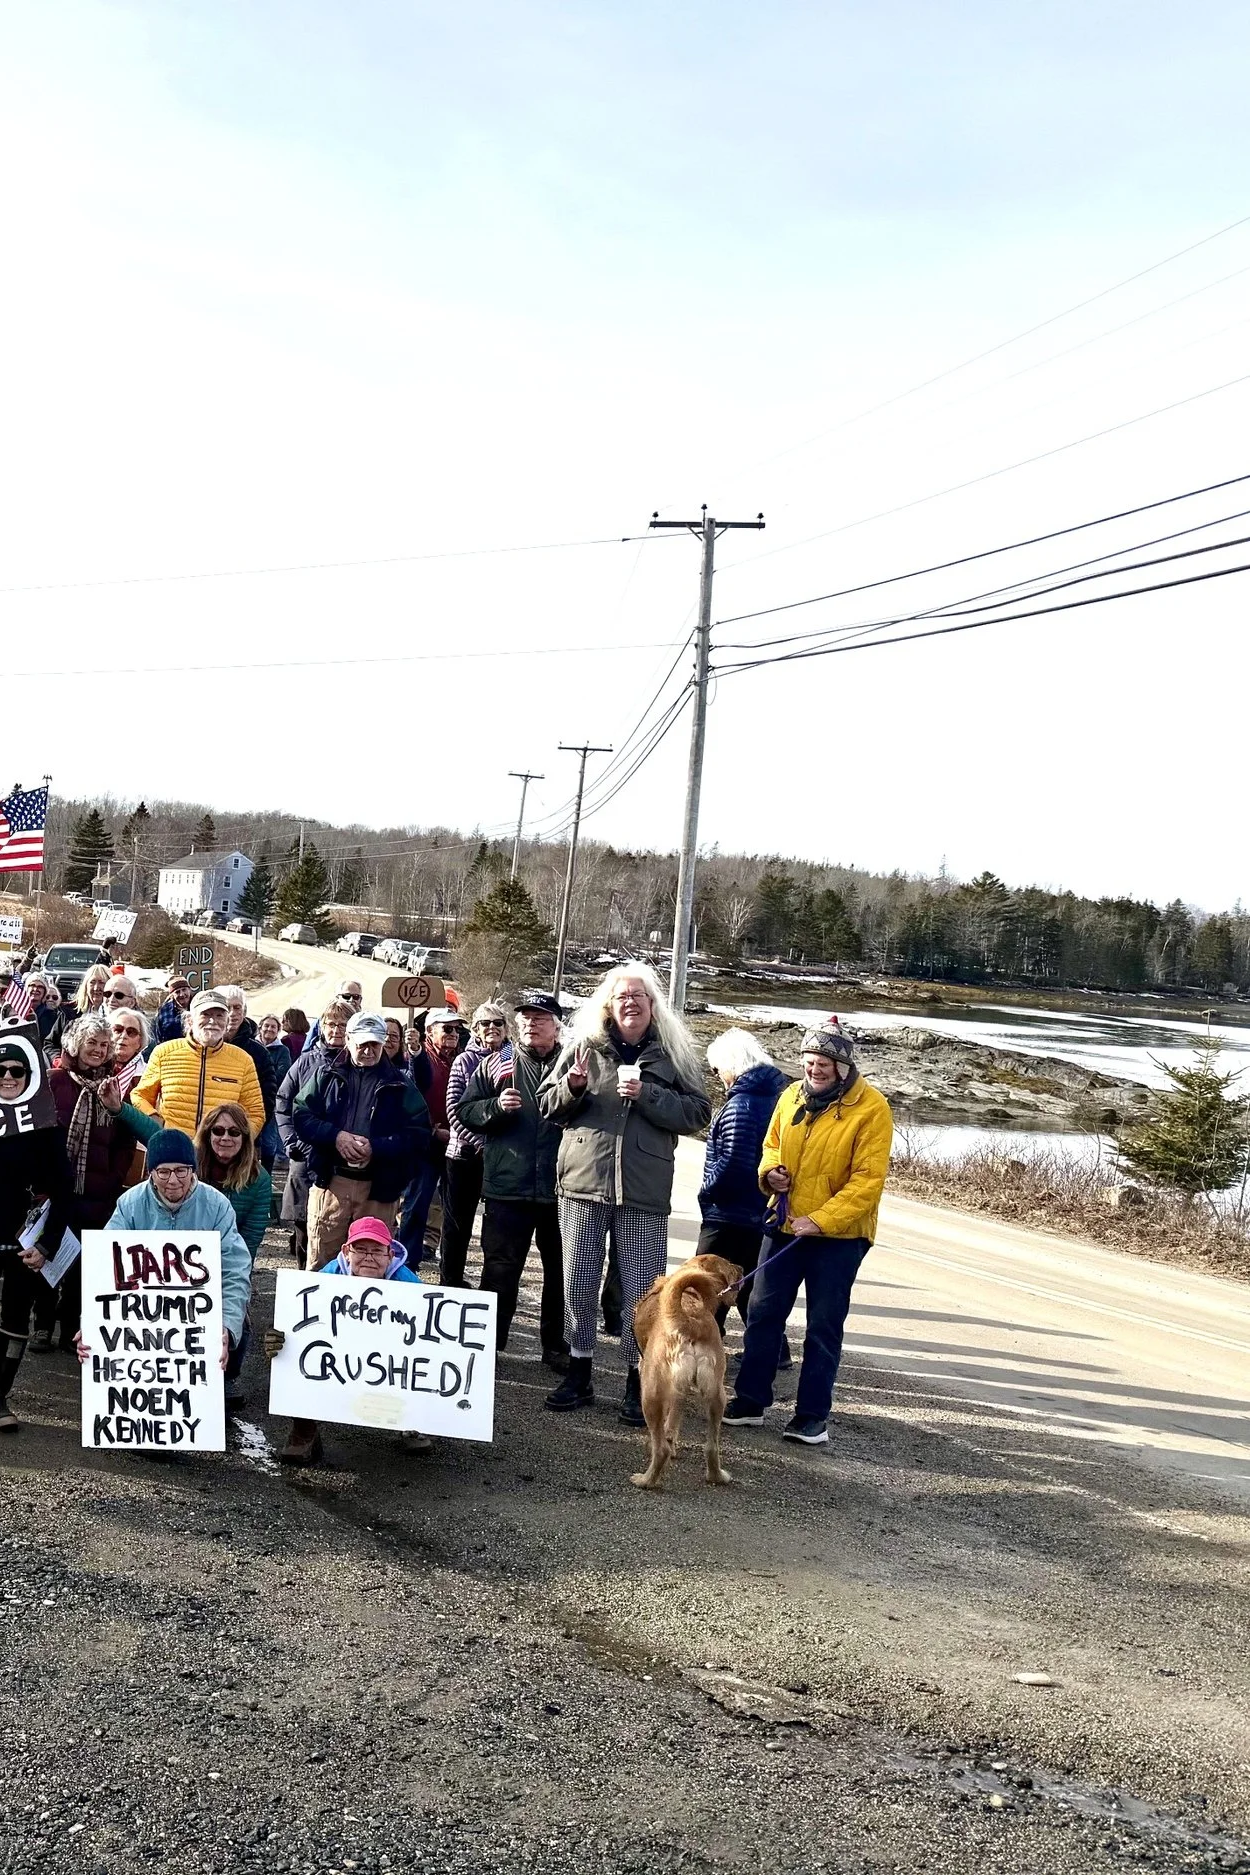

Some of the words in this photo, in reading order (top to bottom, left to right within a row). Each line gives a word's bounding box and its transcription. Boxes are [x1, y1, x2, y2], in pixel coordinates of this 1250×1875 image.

[8, 920, 21, 928] all
[178, 946, 213, 966] END
[178, 969, 211, 991] CE
[404, 985, 426, 997] ICE
[112, 1241, 210, 1291] LIARS
[94, 1292, 213, 1324] TRUMP
[292, 1284, 320, 1332] I
[330, 1286, 388, 1337] prefer
[390, 1309, 417, 1346] my
[418, 1292, 490, 1351] ICE
[99, 1325, 206, 1355] VANCE
[93, 1354, 208, 1386] HEGSETH
[299, 1340, 477, 1411] CRUSHED!
[108, 1386, 192, 1418] NOEM
[93, 1414, 202, 1446] KENNEDY
